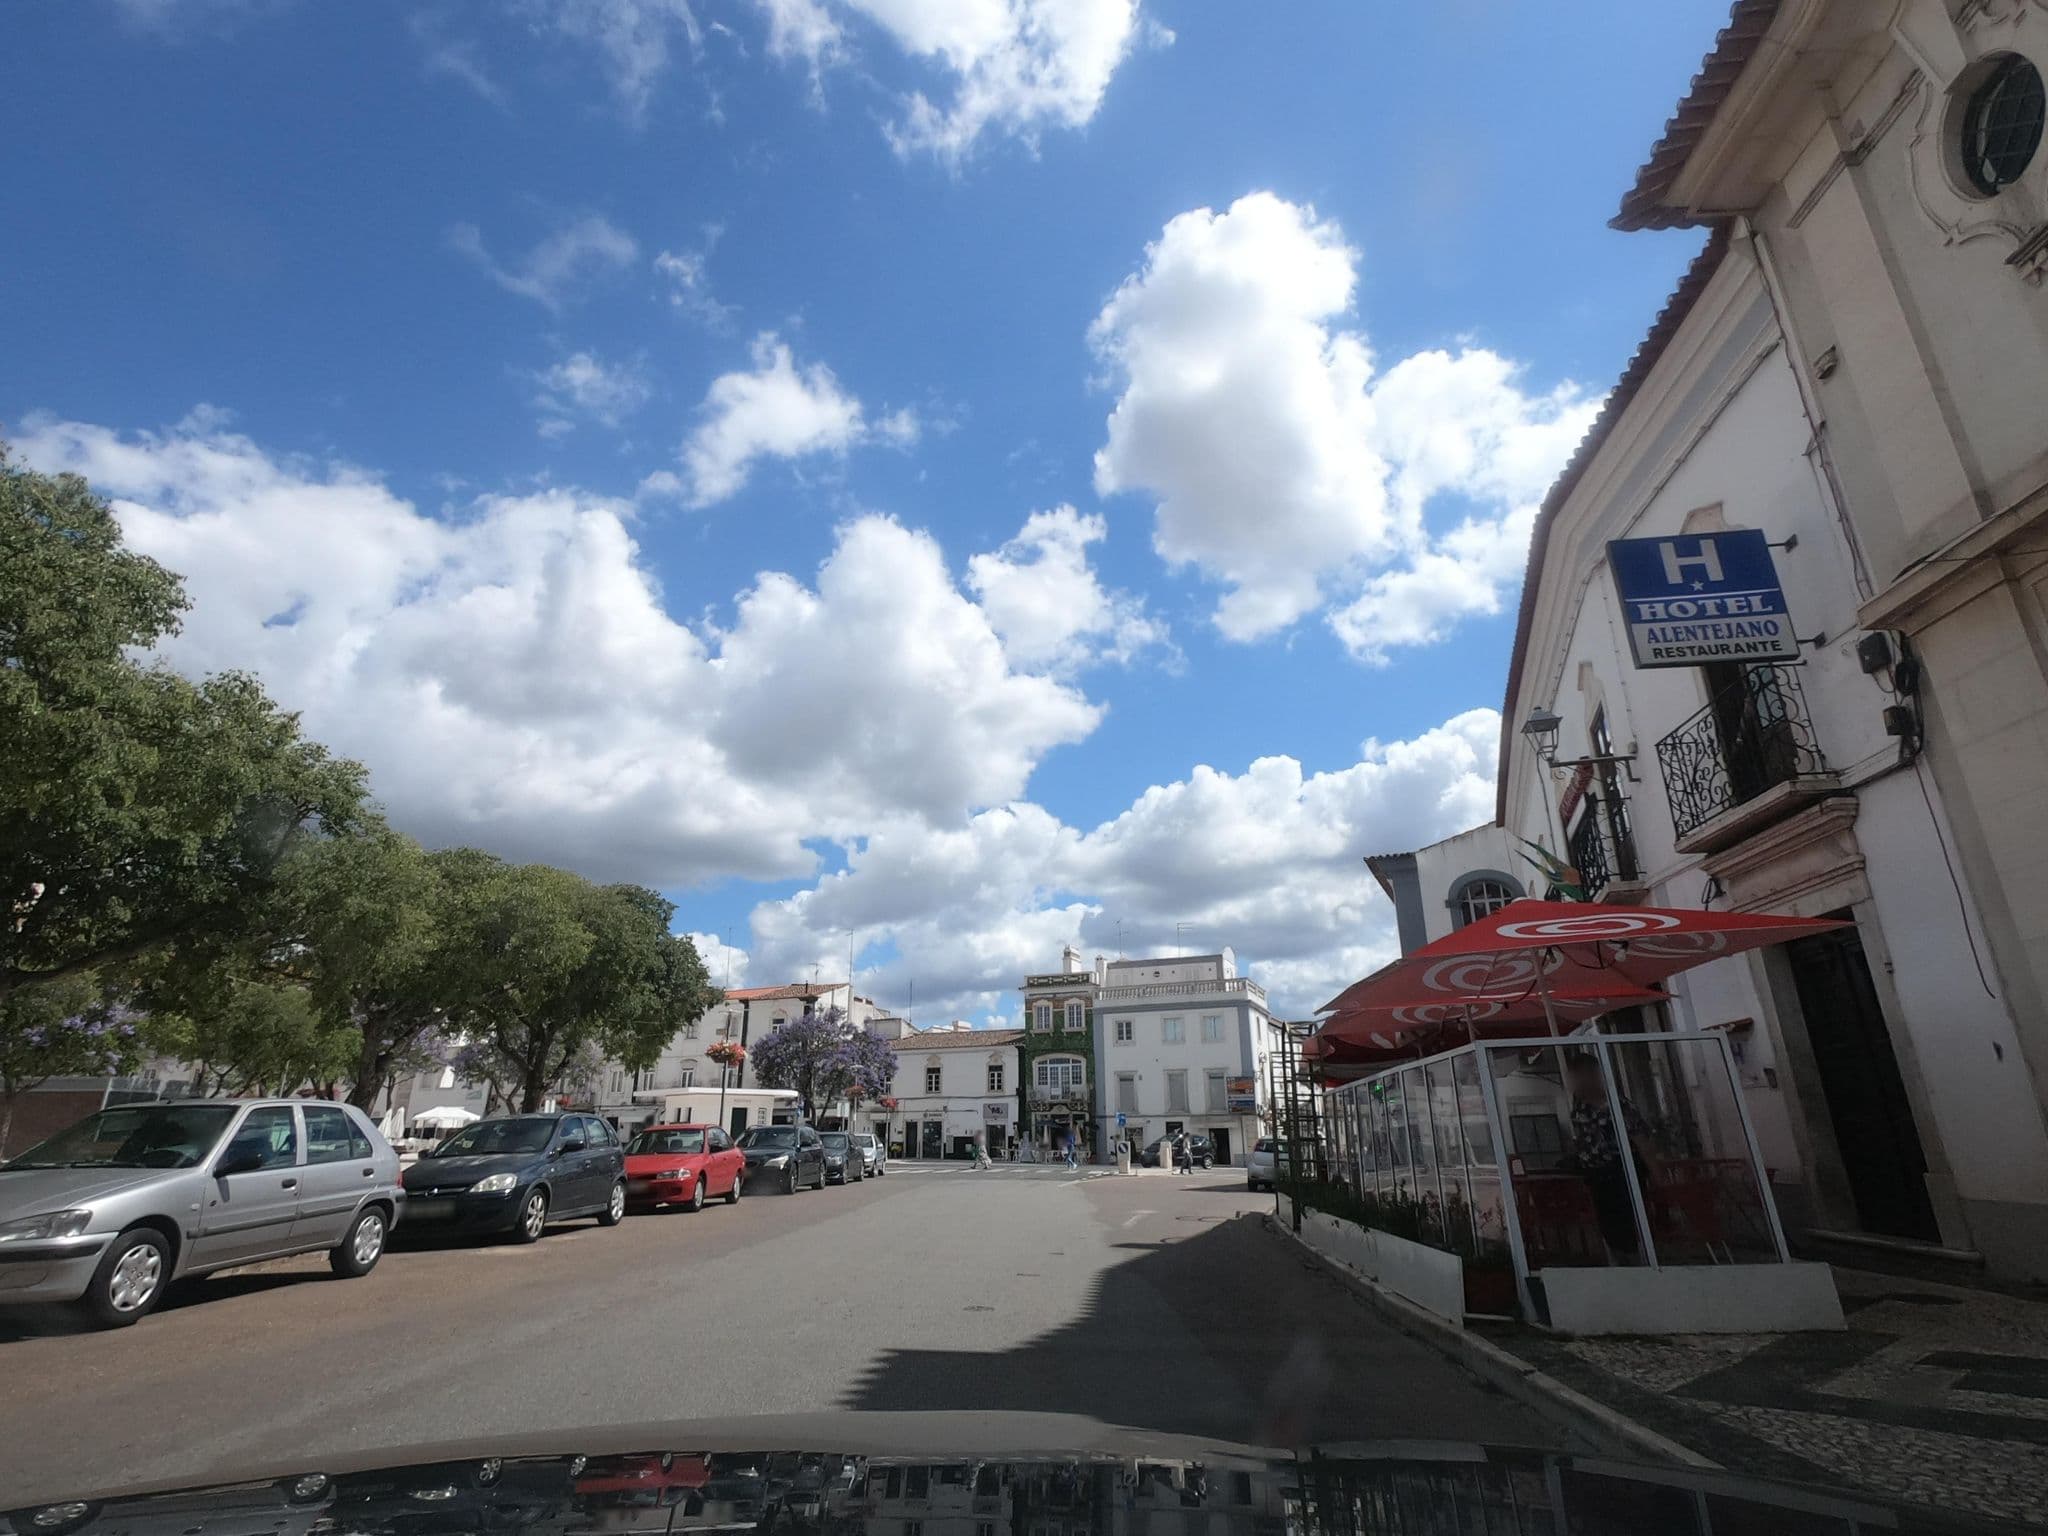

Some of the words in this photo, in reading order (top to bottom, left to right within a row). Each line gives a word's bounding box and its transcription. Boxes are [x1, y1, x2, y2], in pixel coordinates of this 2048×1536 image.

[1659, 538, 1724, 585] H
[1637, 595, 1773, 620] HOTEL
[1647, 619, 1779, 643] ALENTEJANO
[1652, 640, 1783, 659] RESTAURANTE
